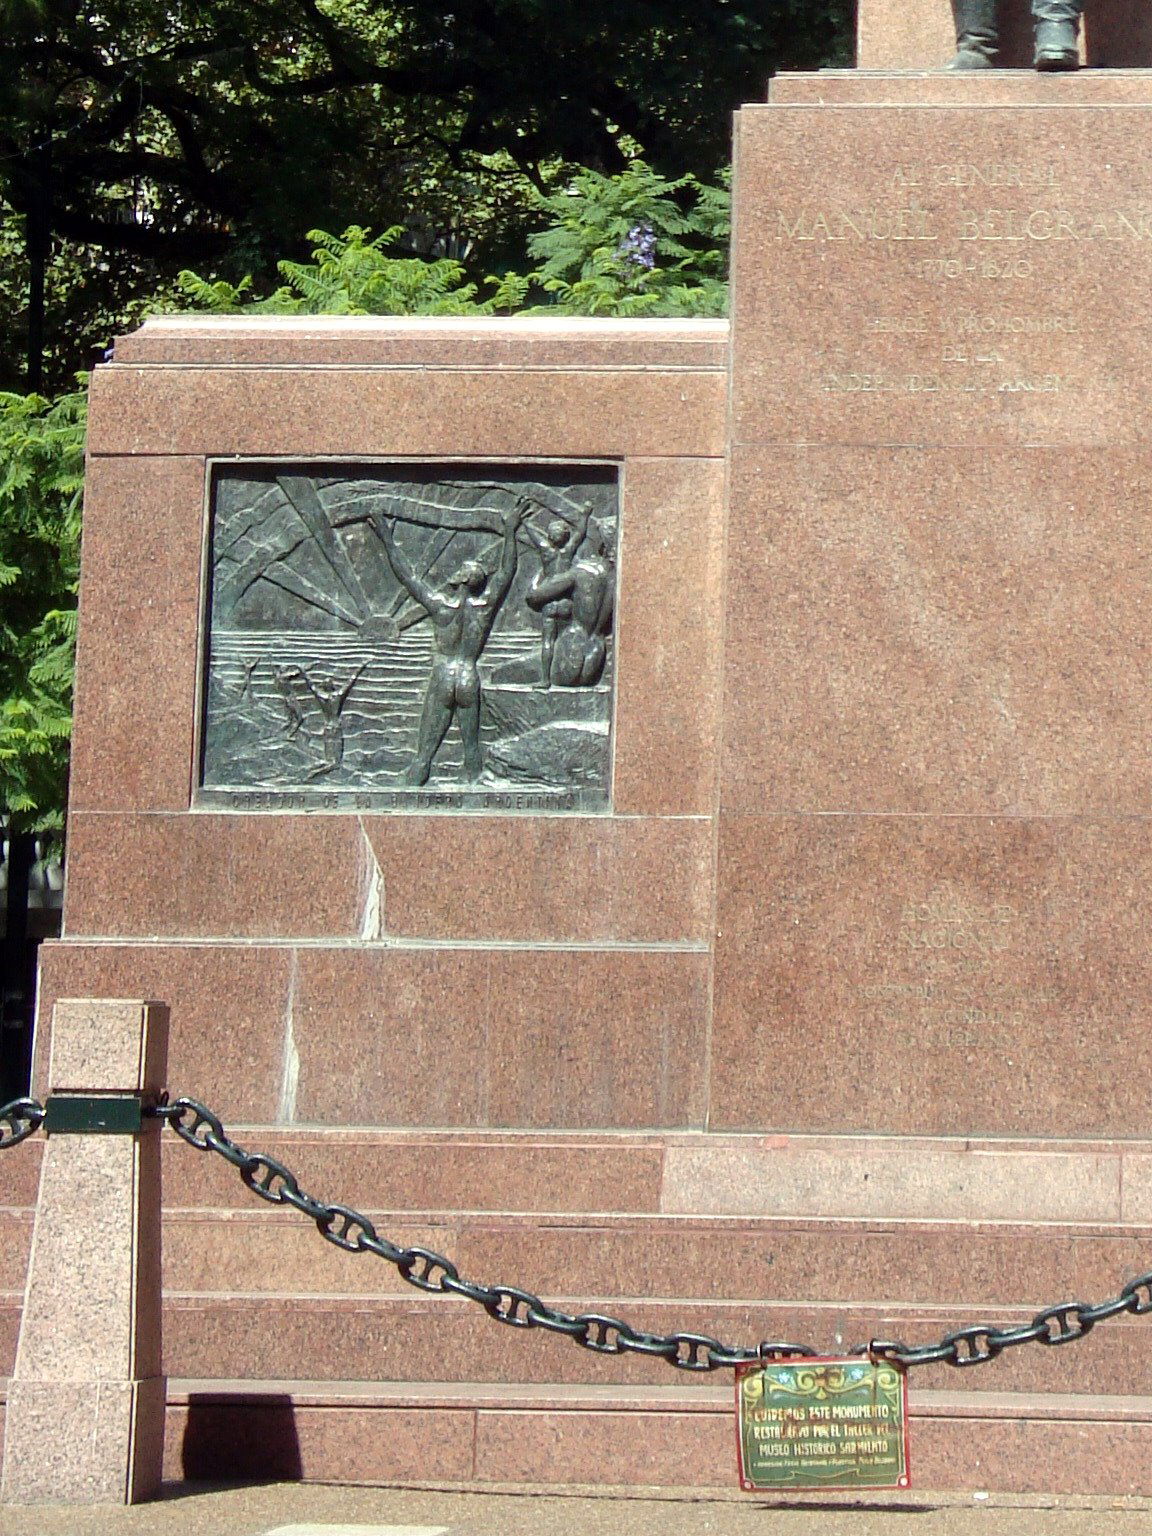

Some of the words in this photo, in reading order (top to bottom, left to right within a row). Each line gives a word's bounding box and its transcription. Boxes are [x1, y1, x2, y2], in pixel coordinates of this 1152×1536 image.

[775, 209, 938, 241] MANUEL
[809, 1406, 830, 1419] ESTE
[830, 1424, 841, 1437] EL
[759, 1443, 790, 1456] MUSEO
